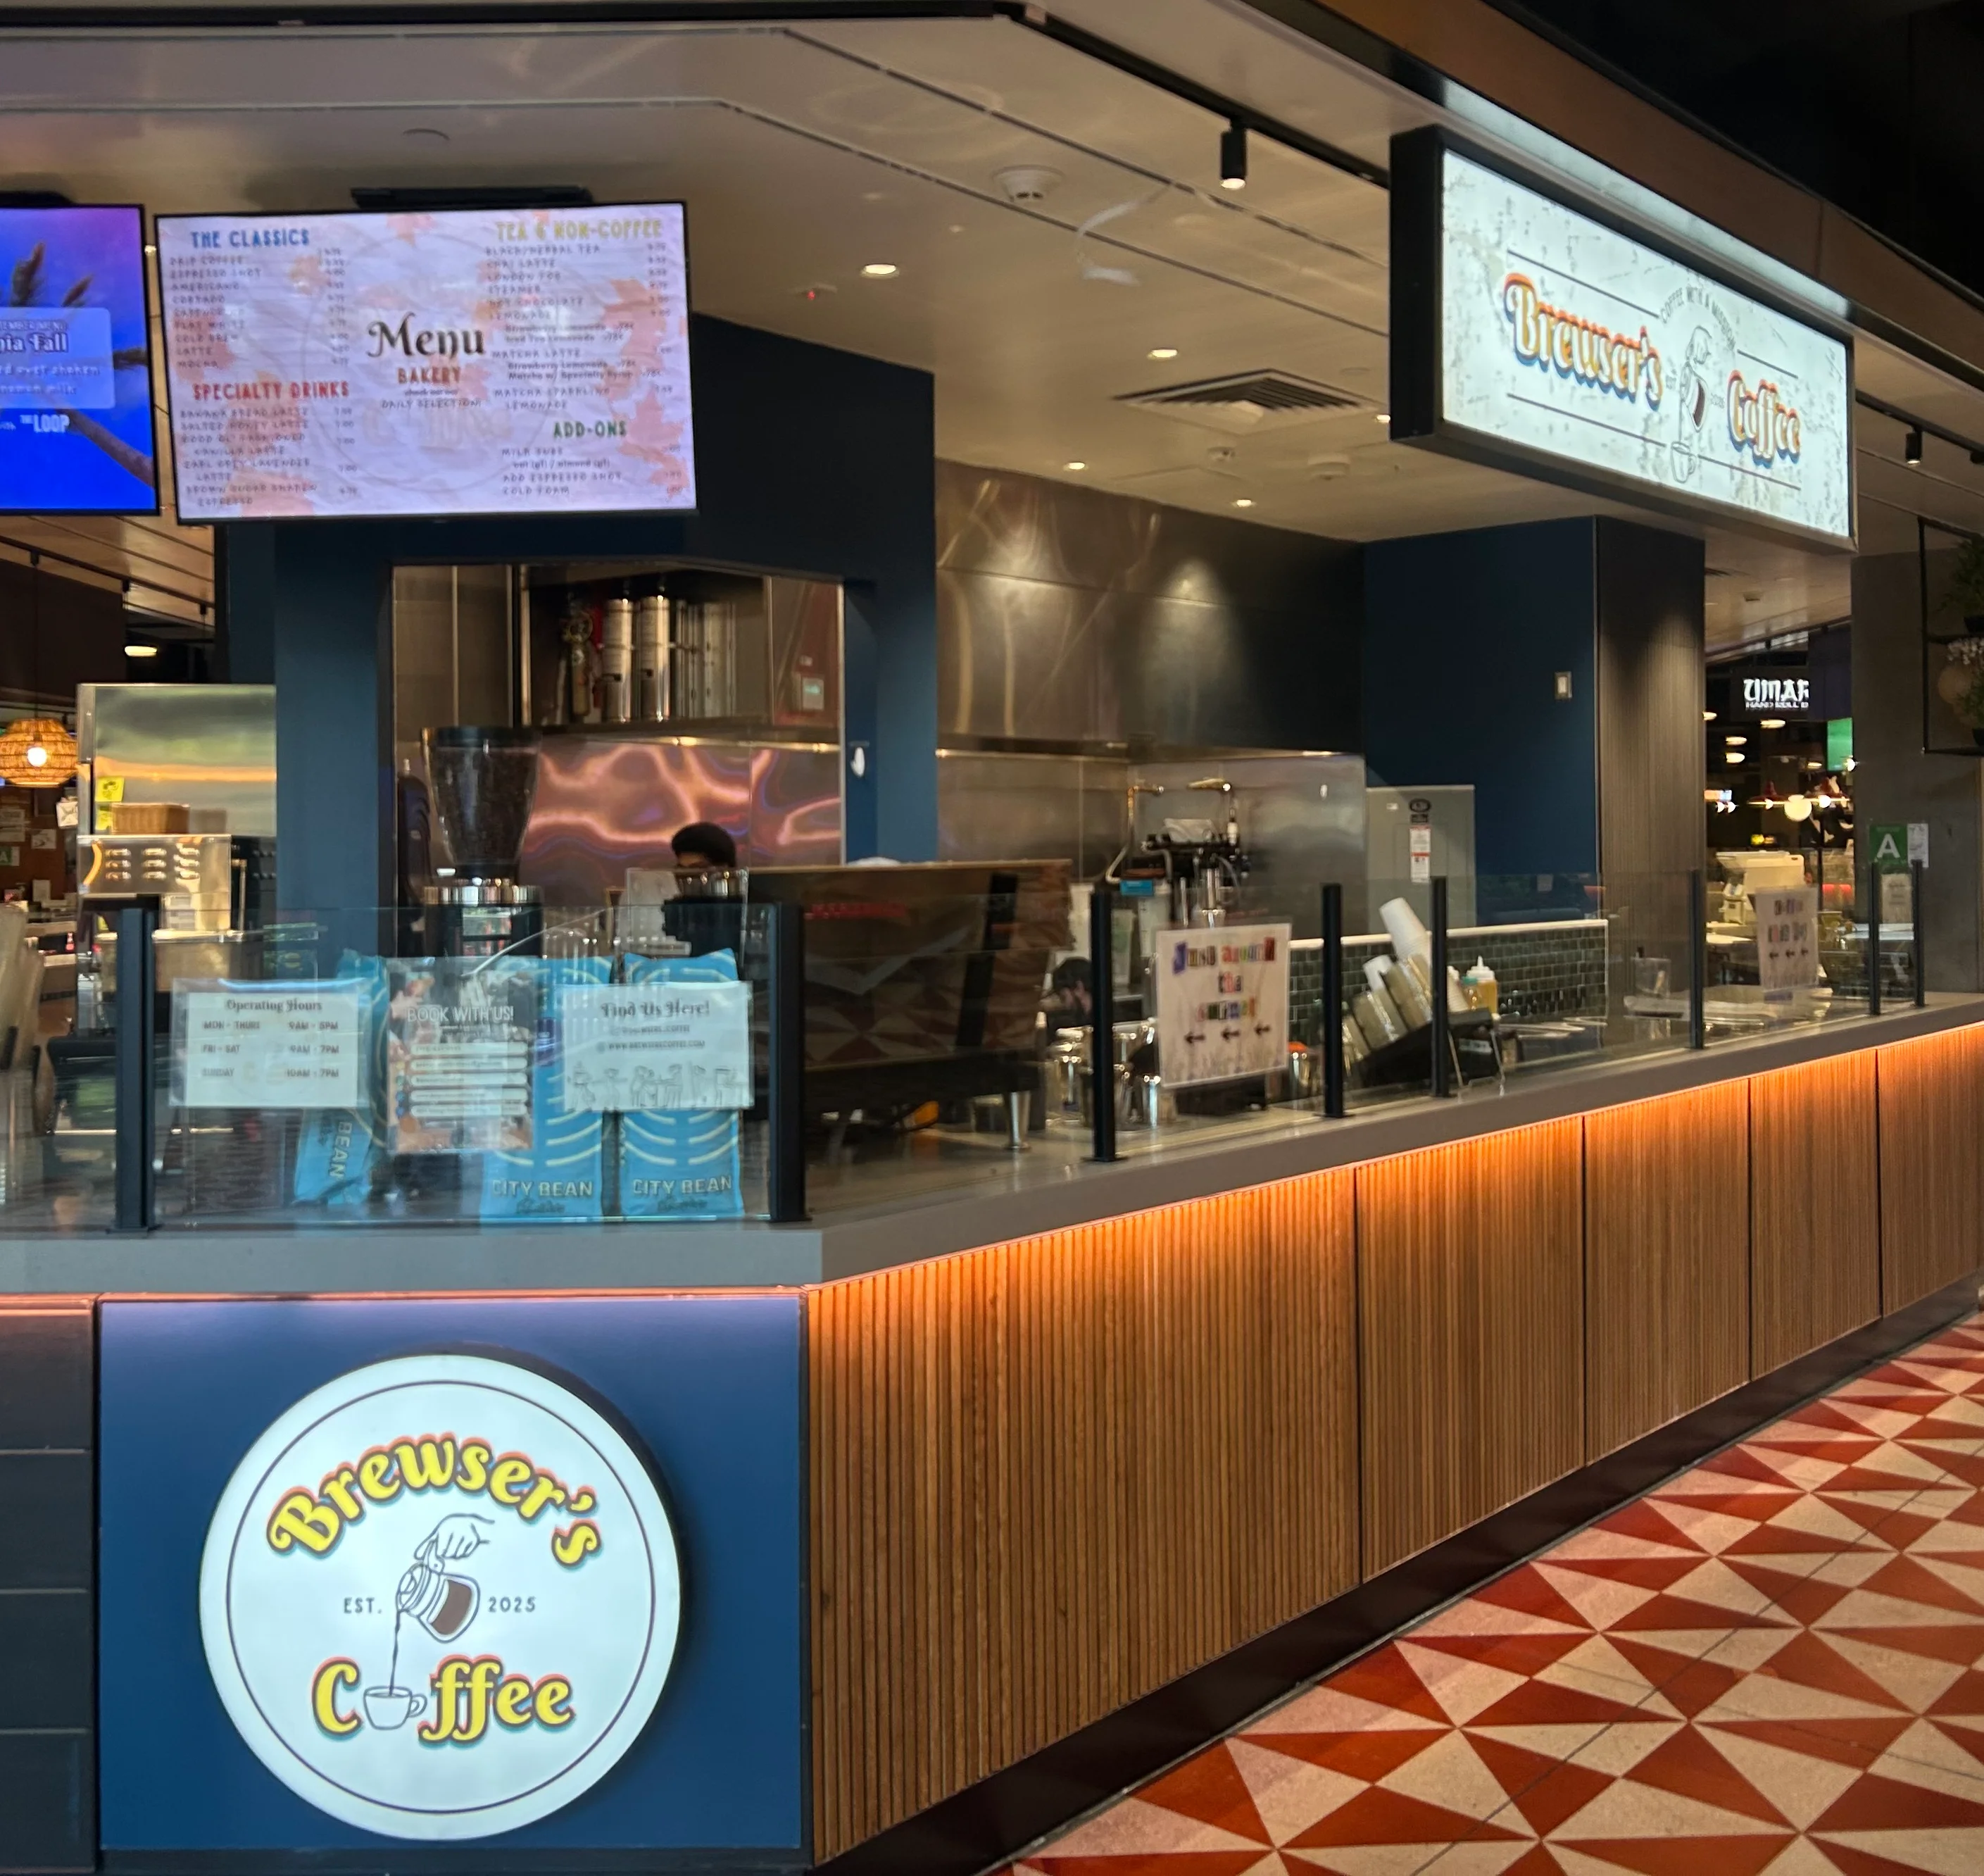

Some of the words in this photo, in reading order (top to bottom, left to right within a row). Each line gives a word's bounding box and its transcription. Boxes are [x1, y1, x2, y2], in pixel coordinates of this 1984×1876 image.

[190, 230, 222, 249] THE
[229, 228, 310, 247] CLASSICS
[496, 221, 527, 241] TEA
[553, 219, 663, 240] NON-COFFEE
[577, 244, 601, 254] TEA
[518, 258, 555, 267] LATTE
[29, 333, 68, 351] Fall
[366, 311, 486, 359] Menu
[177, 346, 213, 355] LATTE
[492, 349, 539, 358] MATCHA
[545, 349, 581, 358] LATTE
[397, 366, 461, 384] BAKERY
[1504, 273, 1663, 411] Brewser's
[1727, 370, 1801, 469] Coffee
[192, 382, 282, 401] SPECIALTY
[289, 380, 349, 399] DRINKS
[494, 389, 541, 398] MATCHA
[382, 400, 413, 408] DAILY
[34, 414, 70, 433] LOOP
[553, 420, 627, 439] ADD-ONS
[503, 473, 525, 482] ADD
[1876, 833, 1900, 858] A
[226, 999, 283, 1013] Operating
[286, 998, 323, 1012] Hours
[407, 1007, 449, 1022] BOOK
[453, 1006, 489, 1021] WITH
[493, 1006, 515, 1022] US!
[601, 1001, 636, 1018] Find
[640, 1001, 662, 1016] Us
[665, 999, 710, 1018] Here!
[203, 1021, 225, 1030] MON
[320, 1044, 339, 1054] 7PM
[287, 1068, 310, 1077] 10AM
[320, 1068, 339, 1077] 7PM
[329, 1121, 352, 1180] BEAN
[493, 1180, 535, 1197] CITY
[538, 1181, 594, 1197] BEAN
[634, 1178, 677, 1196] CITY
[681, 1175, 733, 1194] BEAN
[266, 1432, 601, 1570] Brewser's
[344, 1596, 382, 1614] EST.
[487, 1596, 536, 1613] 2025
